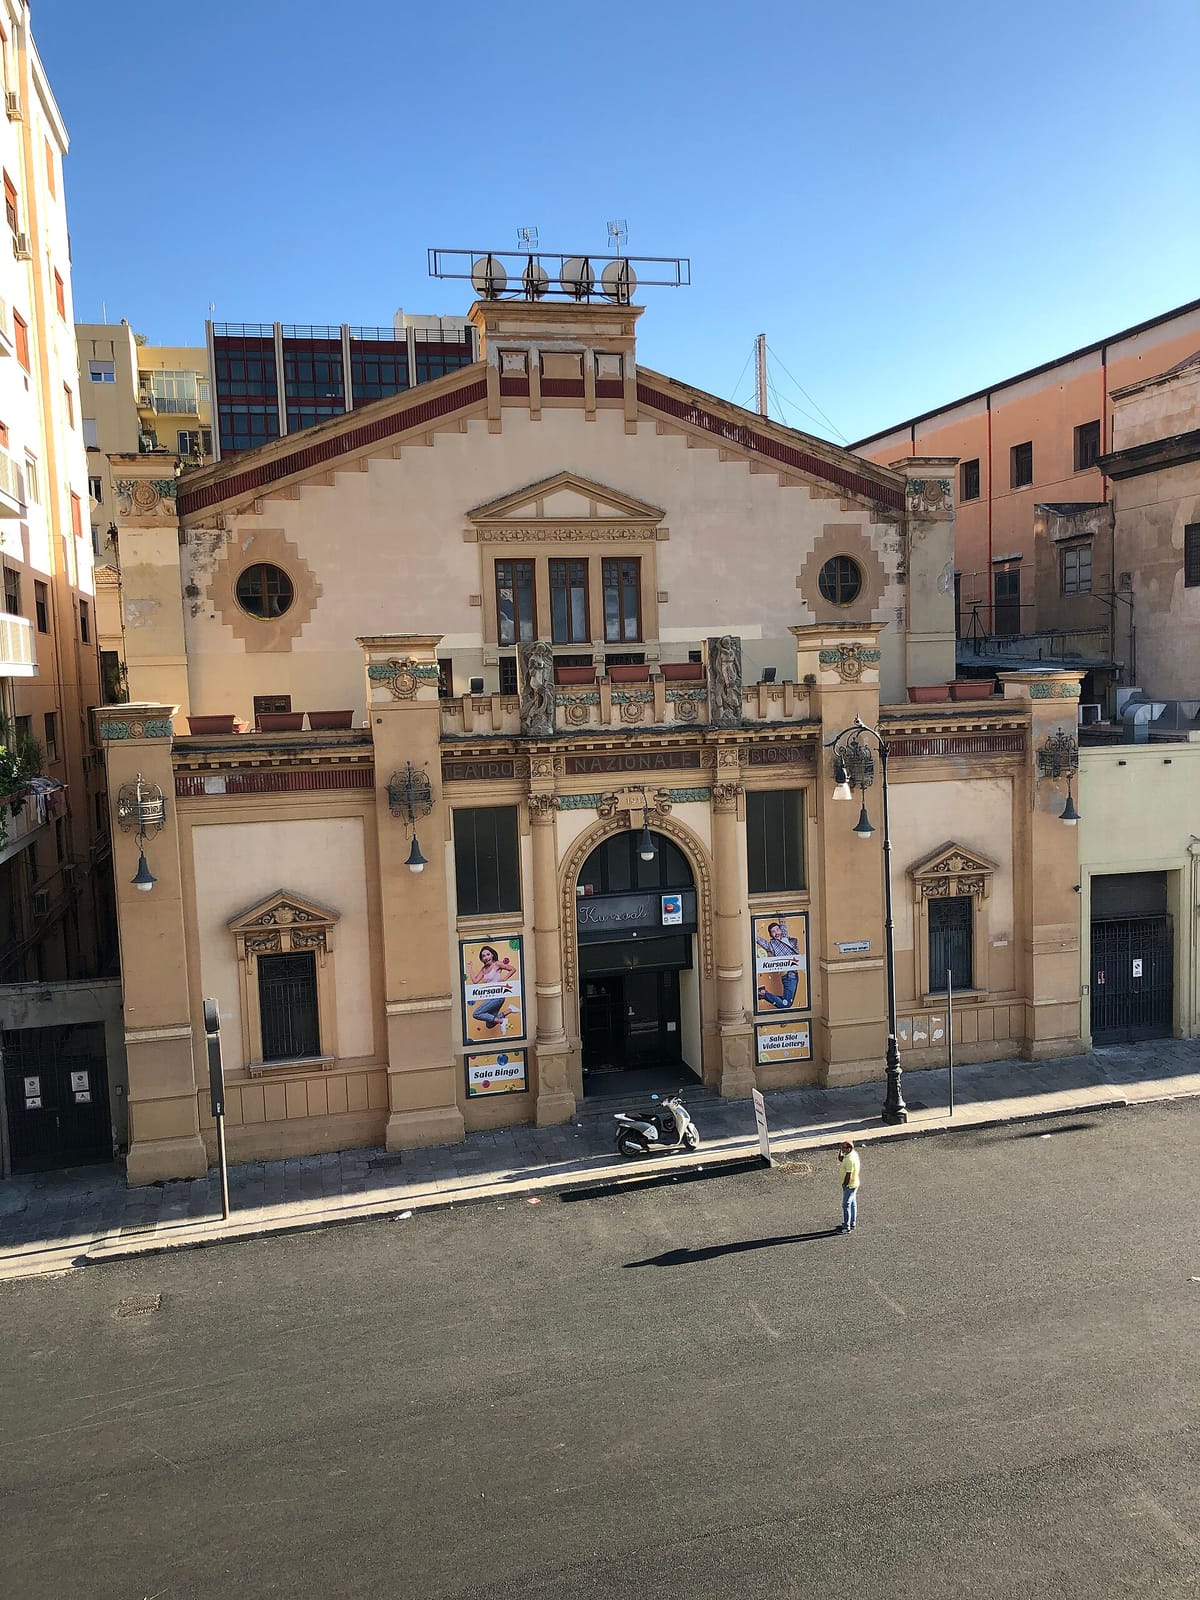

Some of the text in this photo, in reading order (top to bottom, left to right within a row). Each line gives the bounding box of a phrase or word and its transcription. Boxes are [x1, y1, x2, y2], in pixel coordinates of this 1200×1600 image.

[442, 761, 512, 779] TEATRO
[574, 751, 693, 771] NAZIONALE
[762, 960, 791, 968] Kursaal
[472, 987, 503, 996] Kursaal
[782, 1040, 805, 1048] Lottery
[474, 1068, 519, 1079] Sala Bingo
